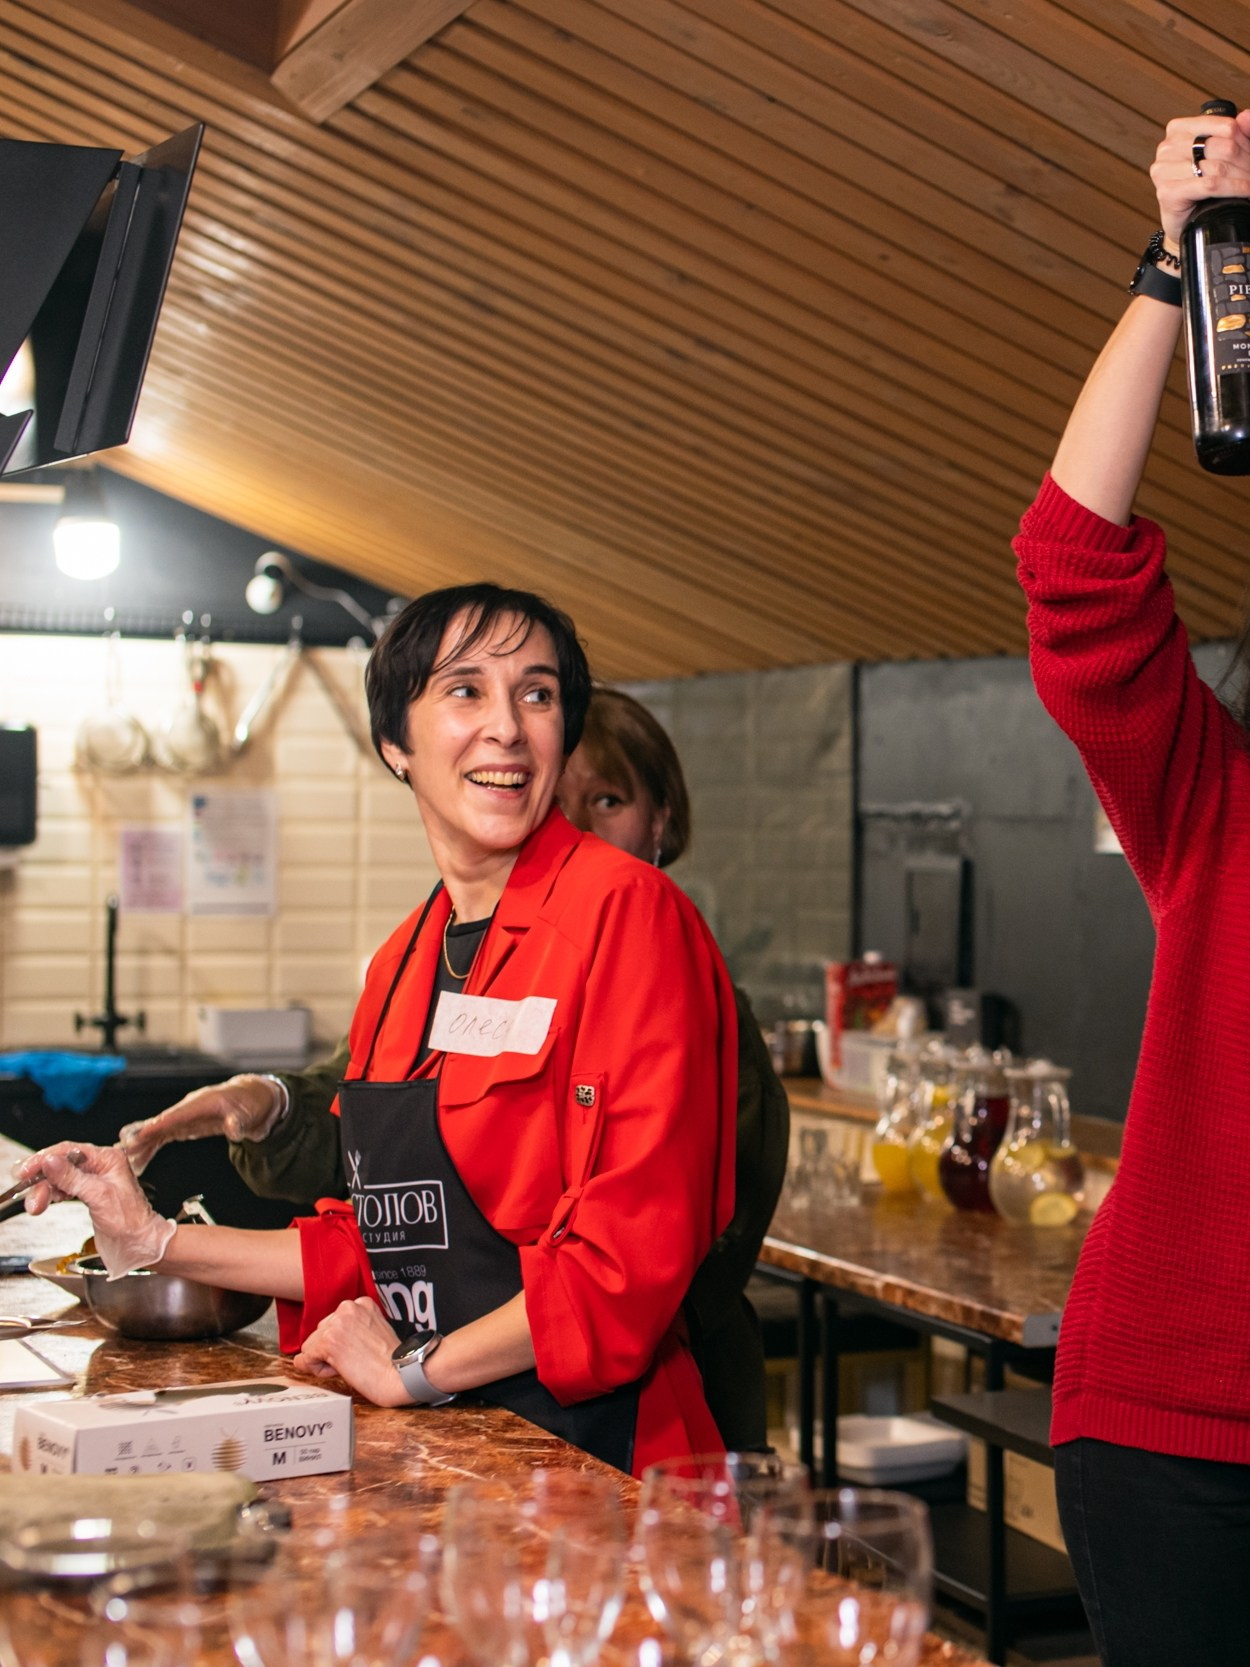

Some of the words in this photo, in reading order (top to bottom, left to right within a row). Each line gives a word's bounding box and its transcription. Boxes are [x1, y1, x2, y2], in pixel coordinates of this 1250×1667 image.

[362, 1230, 406, 1245] СТУДИЯ
[375, 1269, 399, 1280] since
[400, 1264, 427, 1279] 1889
[272, 1451, 287, 1466] M
